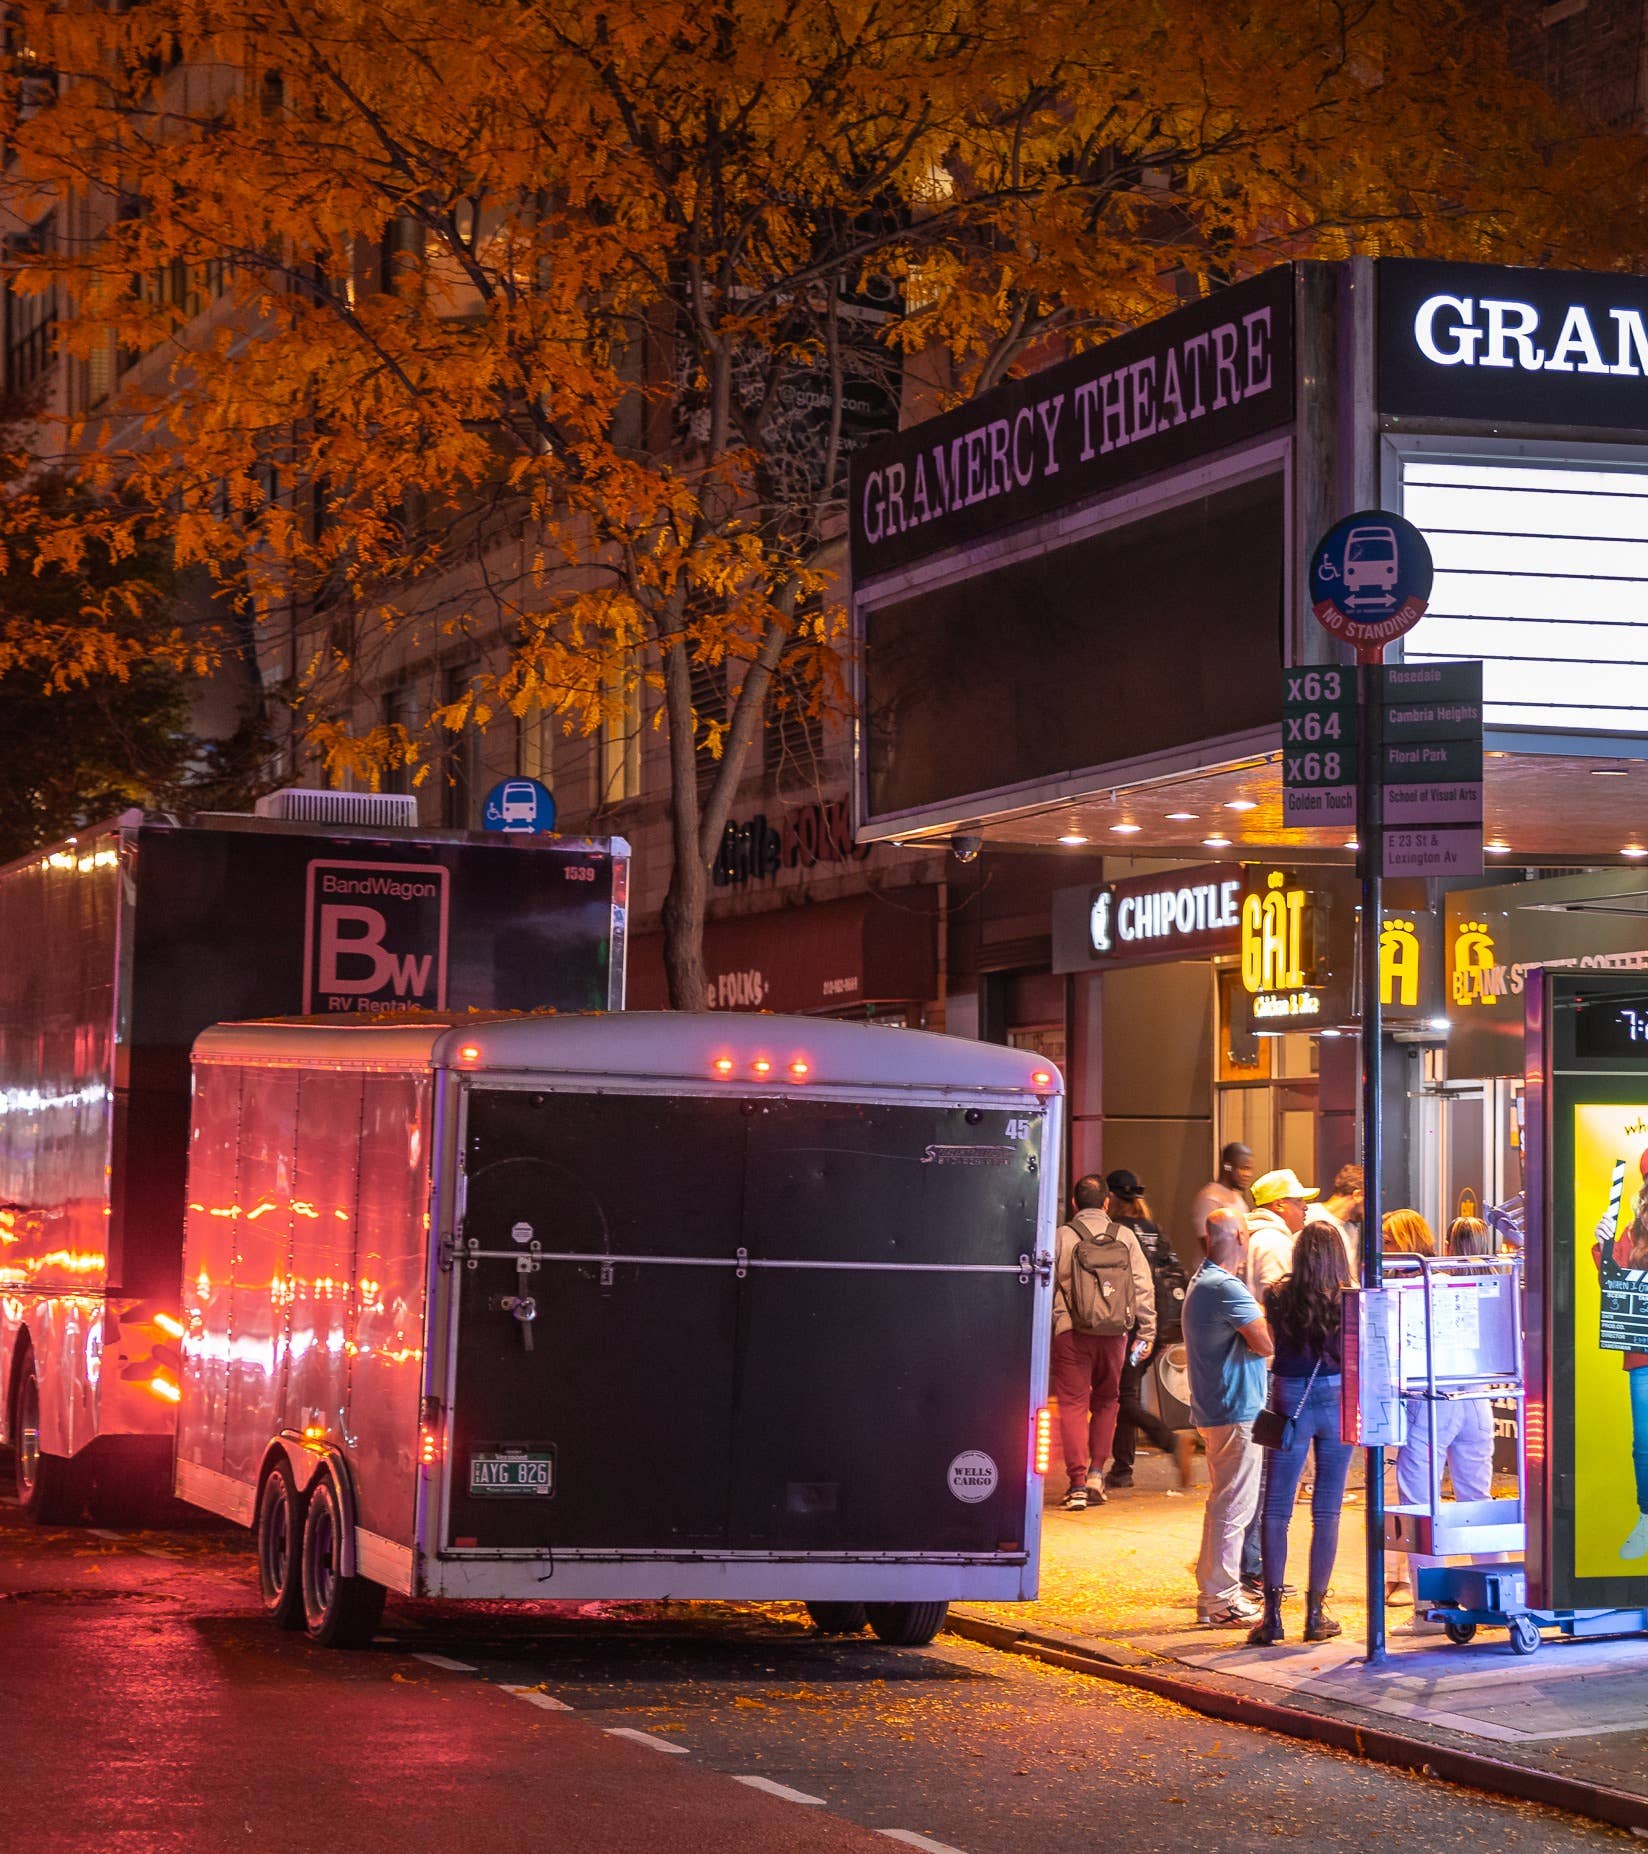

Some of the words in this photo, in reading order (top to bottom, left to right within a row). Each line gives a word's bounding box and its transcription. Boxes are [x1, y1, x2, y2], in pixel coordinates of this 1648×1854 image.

[863, 393, 1064, 545] GRAMERCY
[1075, 305, 1272, 462] THEATRE
[1321, 607, 1342, 629] NO
[1345, 606, 1417, 640] STANDING
[1389, 669, 1441, 684] Rosedale
[1389, 709, 1433, 723] Cambria
[1437, 706, 1478, 722] Heights
[1389, 748, 1420, 763] Floral
[1422, 748, 1448, 762] Park
[1288, 793, 1322, 811] Golden
[1325, 792, 1353, 810] Touch
[1389, 790, 1418, 803] School
[1420, 790, 1429, 802] of
[1431, 789, 1457, 801] Visual
[1459, 788, 1477, 801] Arts
[1389, 836, 1395, 847] E
[1398, 835, 1412, 847] 23
[1416, 835, 1427, 846] St
[1430, 835, 1439, 846] &
[1389, 852, 1440, 866] Lexington
[1444, 852, 1458, 862] Av
[563, 867, 596, 881] 1539
[322, 875, 436, 900] BandWagon
[1118, 880, 1241, 942] CHIPOTLE
[719, 969, 763, 1007] FOLKS
[328, 997, 352, 1011] RV
[1005, 1119, 1030, 1140] 45
[480, 1463, 509, 1483] AYG
[518, 1463, 547, 1483] 826
[954, 1467, 992, 1477] WELLS
[953, 1477, 992, 1486] CARGO
